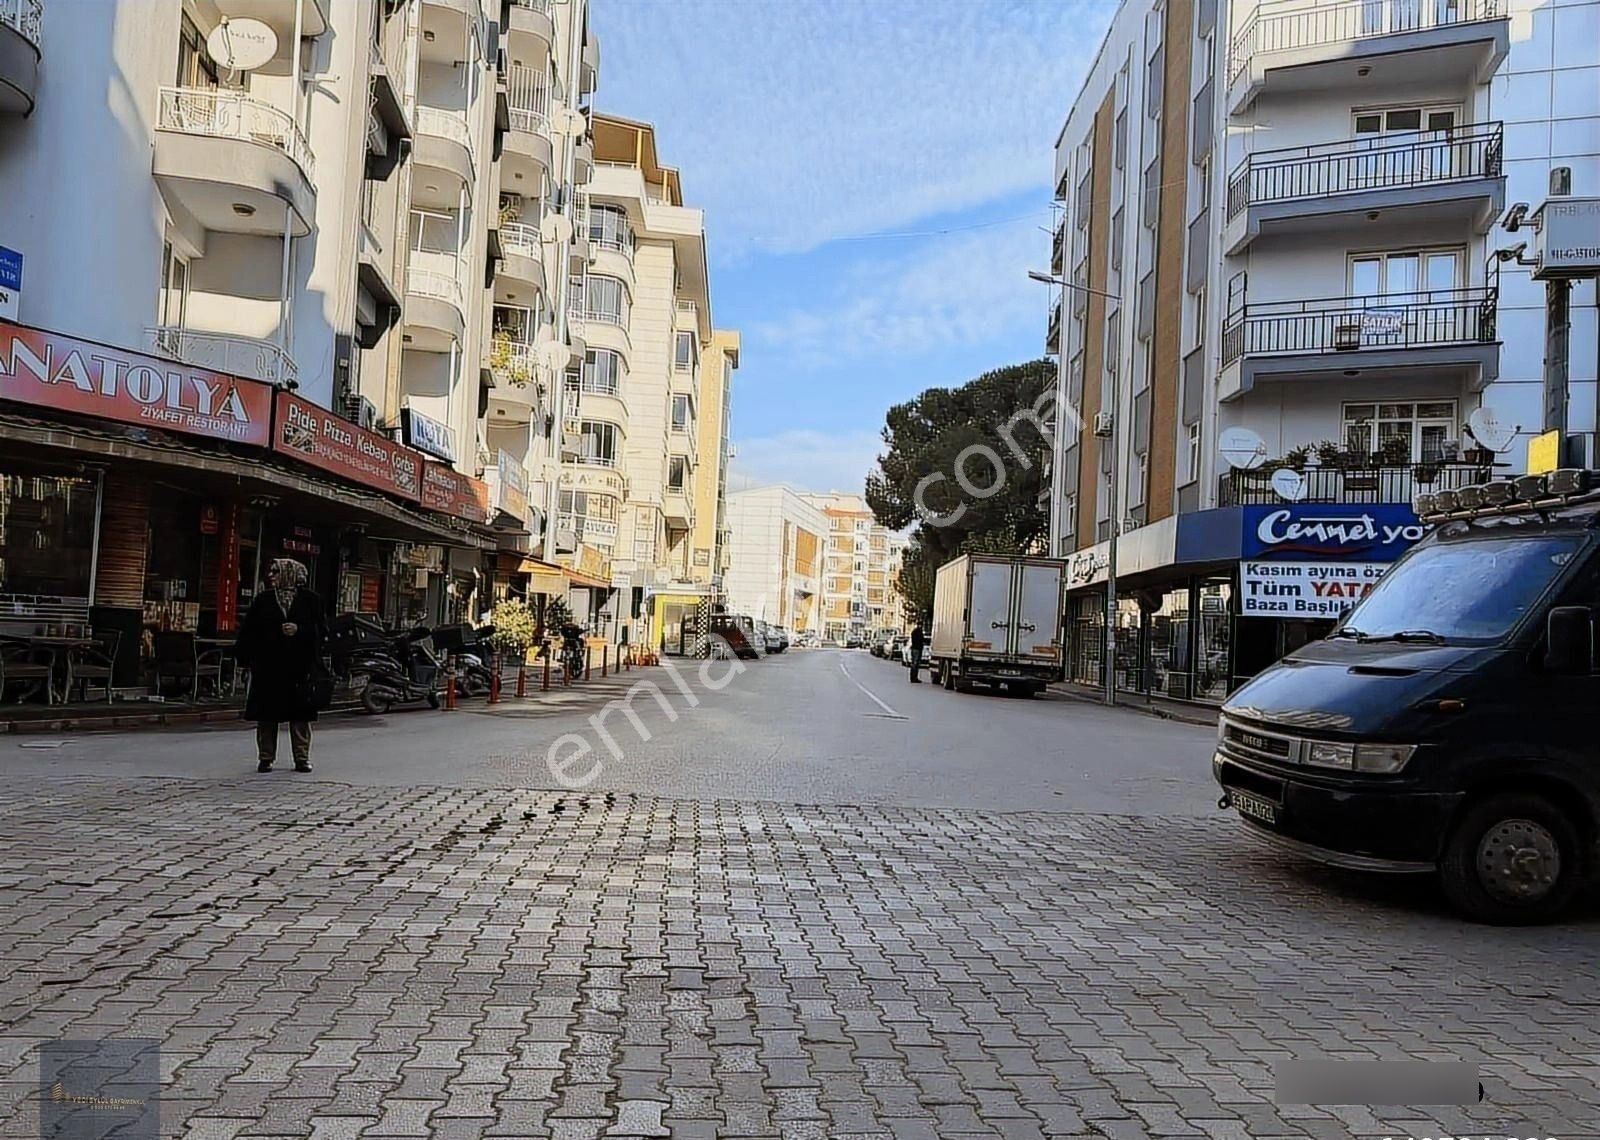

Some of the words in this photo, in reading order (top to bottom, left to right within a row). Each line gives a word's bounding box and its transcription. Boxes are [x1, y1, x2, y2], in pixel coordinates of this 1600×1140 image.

[0, 336, 250, 422] NATOLYA
[1257, 510, 1378, 544] Cennet
[1246, 563, 1302, 577] Kasım
[1307, 565, 1357, 580] ayına
[1246, 580, 1301, 597] Tüm
[1246, 599, 1288, 611] Baza
